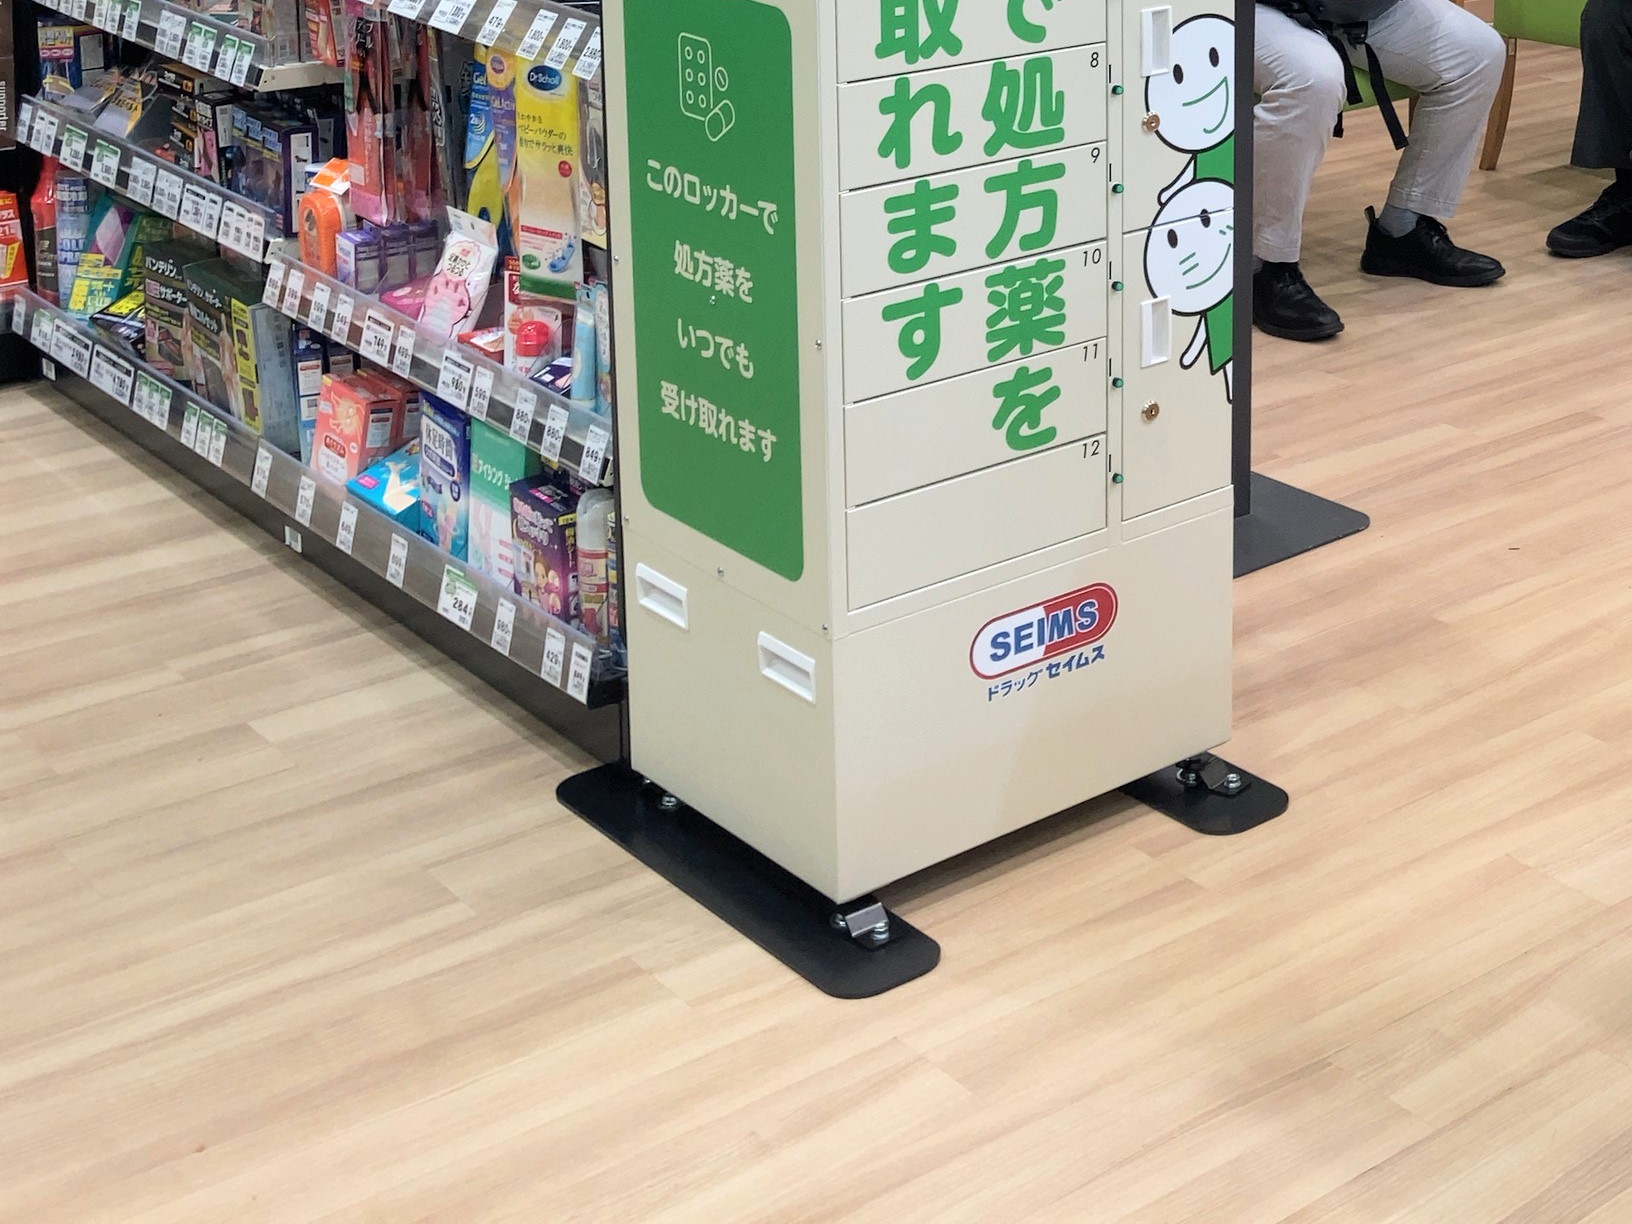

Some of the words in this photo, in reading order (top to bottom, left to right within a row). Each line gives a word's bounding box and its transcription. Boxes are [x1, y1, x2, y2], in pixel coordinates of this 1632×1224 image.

[1090, 52, 1100, 68] 8
[1091, 147, 1101, 164] 9
[645, 159, 779, 235] このロッカーで
[673, 240, 755, 304] 処方薬を
[1083, 248, 1102, 267] 10
[676, 318, 754, 379] いつでも
[1082, 344, 1099, 362] 11
[660, 380, 777, 463] 受け取れます
[1082, 439, 1101, 460] 12
[989, 600, 1099, 663] SEIMS
